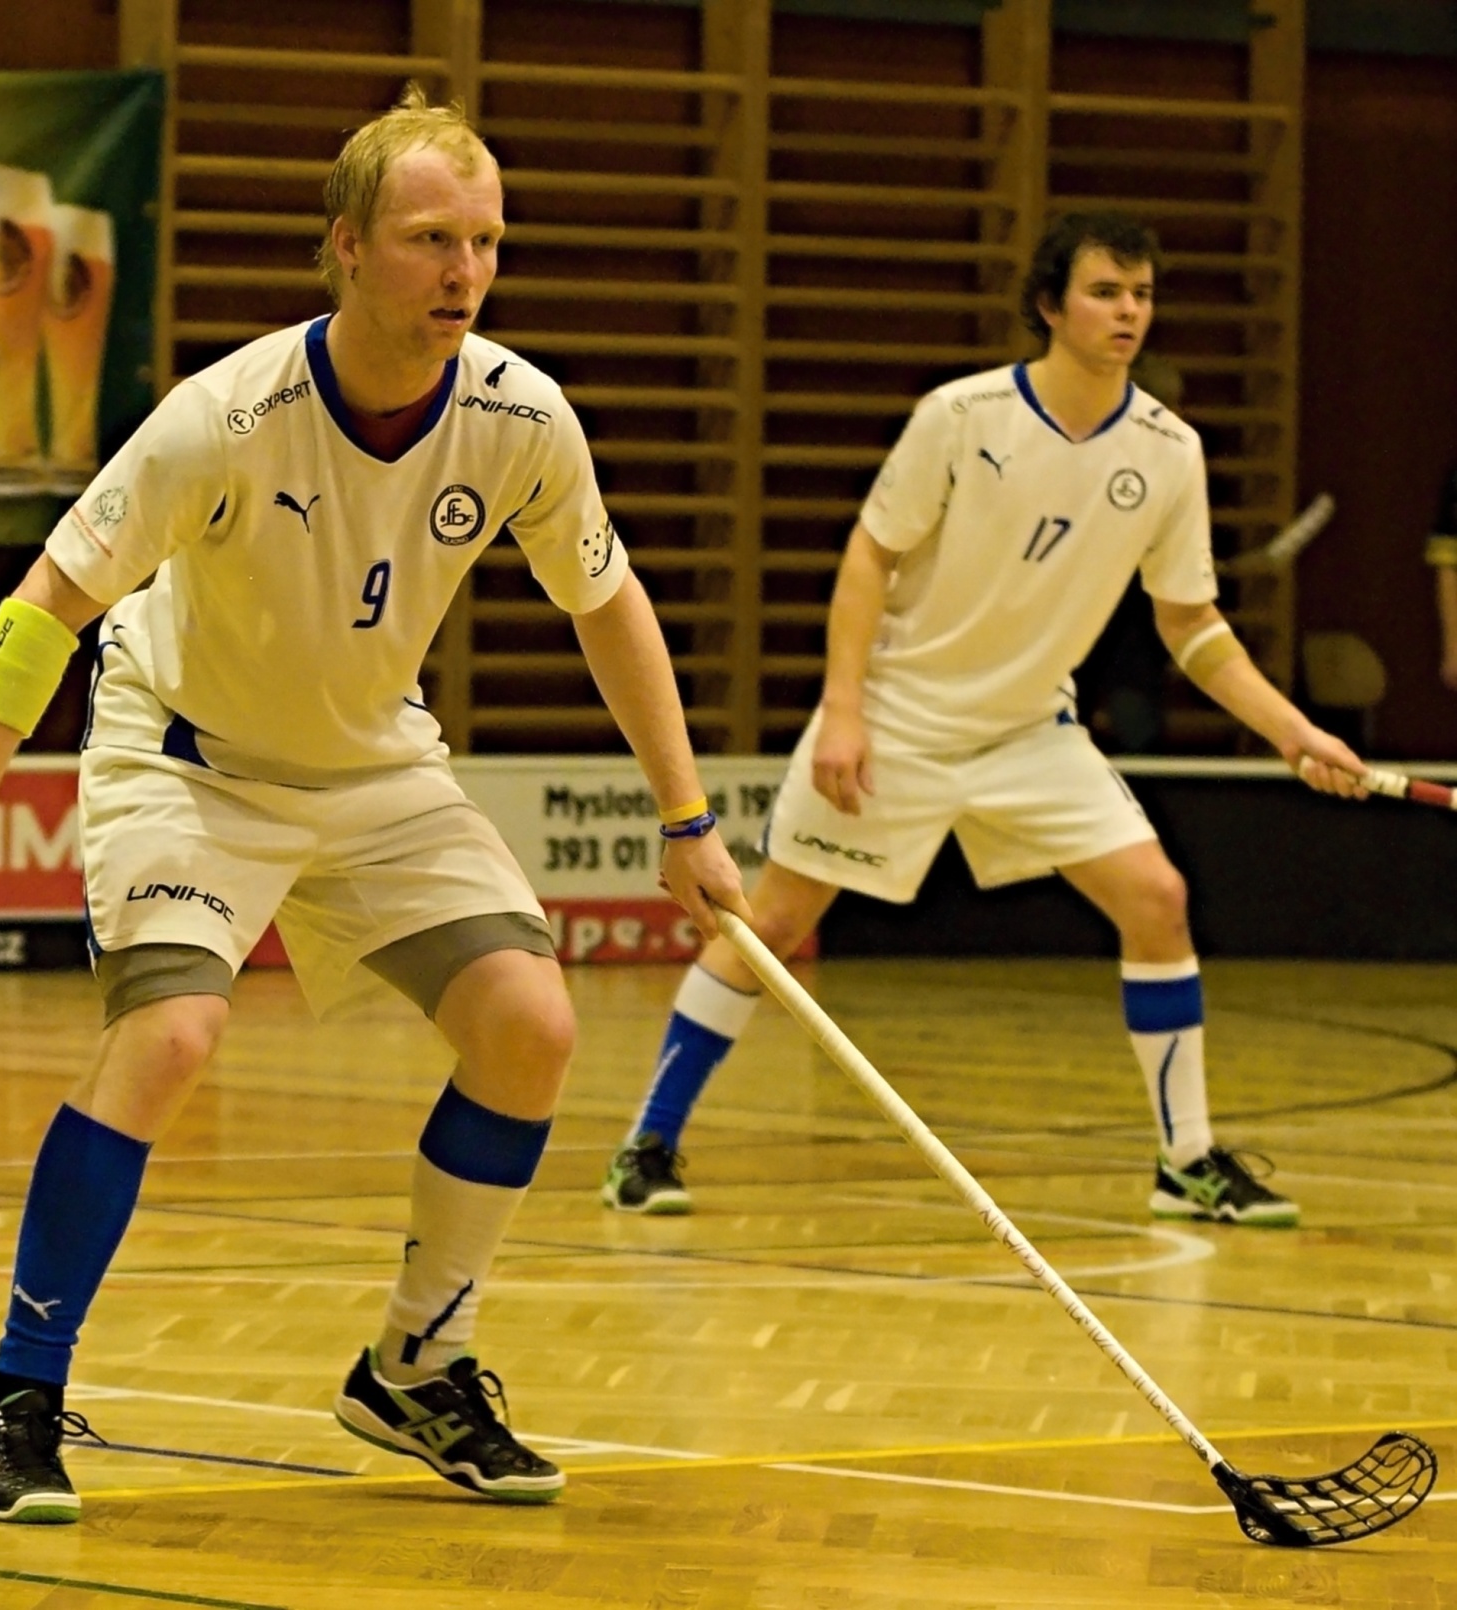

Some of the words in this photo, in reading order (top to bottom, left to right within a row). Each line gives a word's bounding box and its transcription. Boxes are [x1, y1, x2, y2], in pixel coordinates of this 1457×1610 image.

[457, 395, 552, 425] UNIHOC
[1022, 515, 1072, 563] 17
[351, 558, 392, 630] 9
[544, 835, 600, 872] 393
[126, 883, 235, 925] UNIHOC
